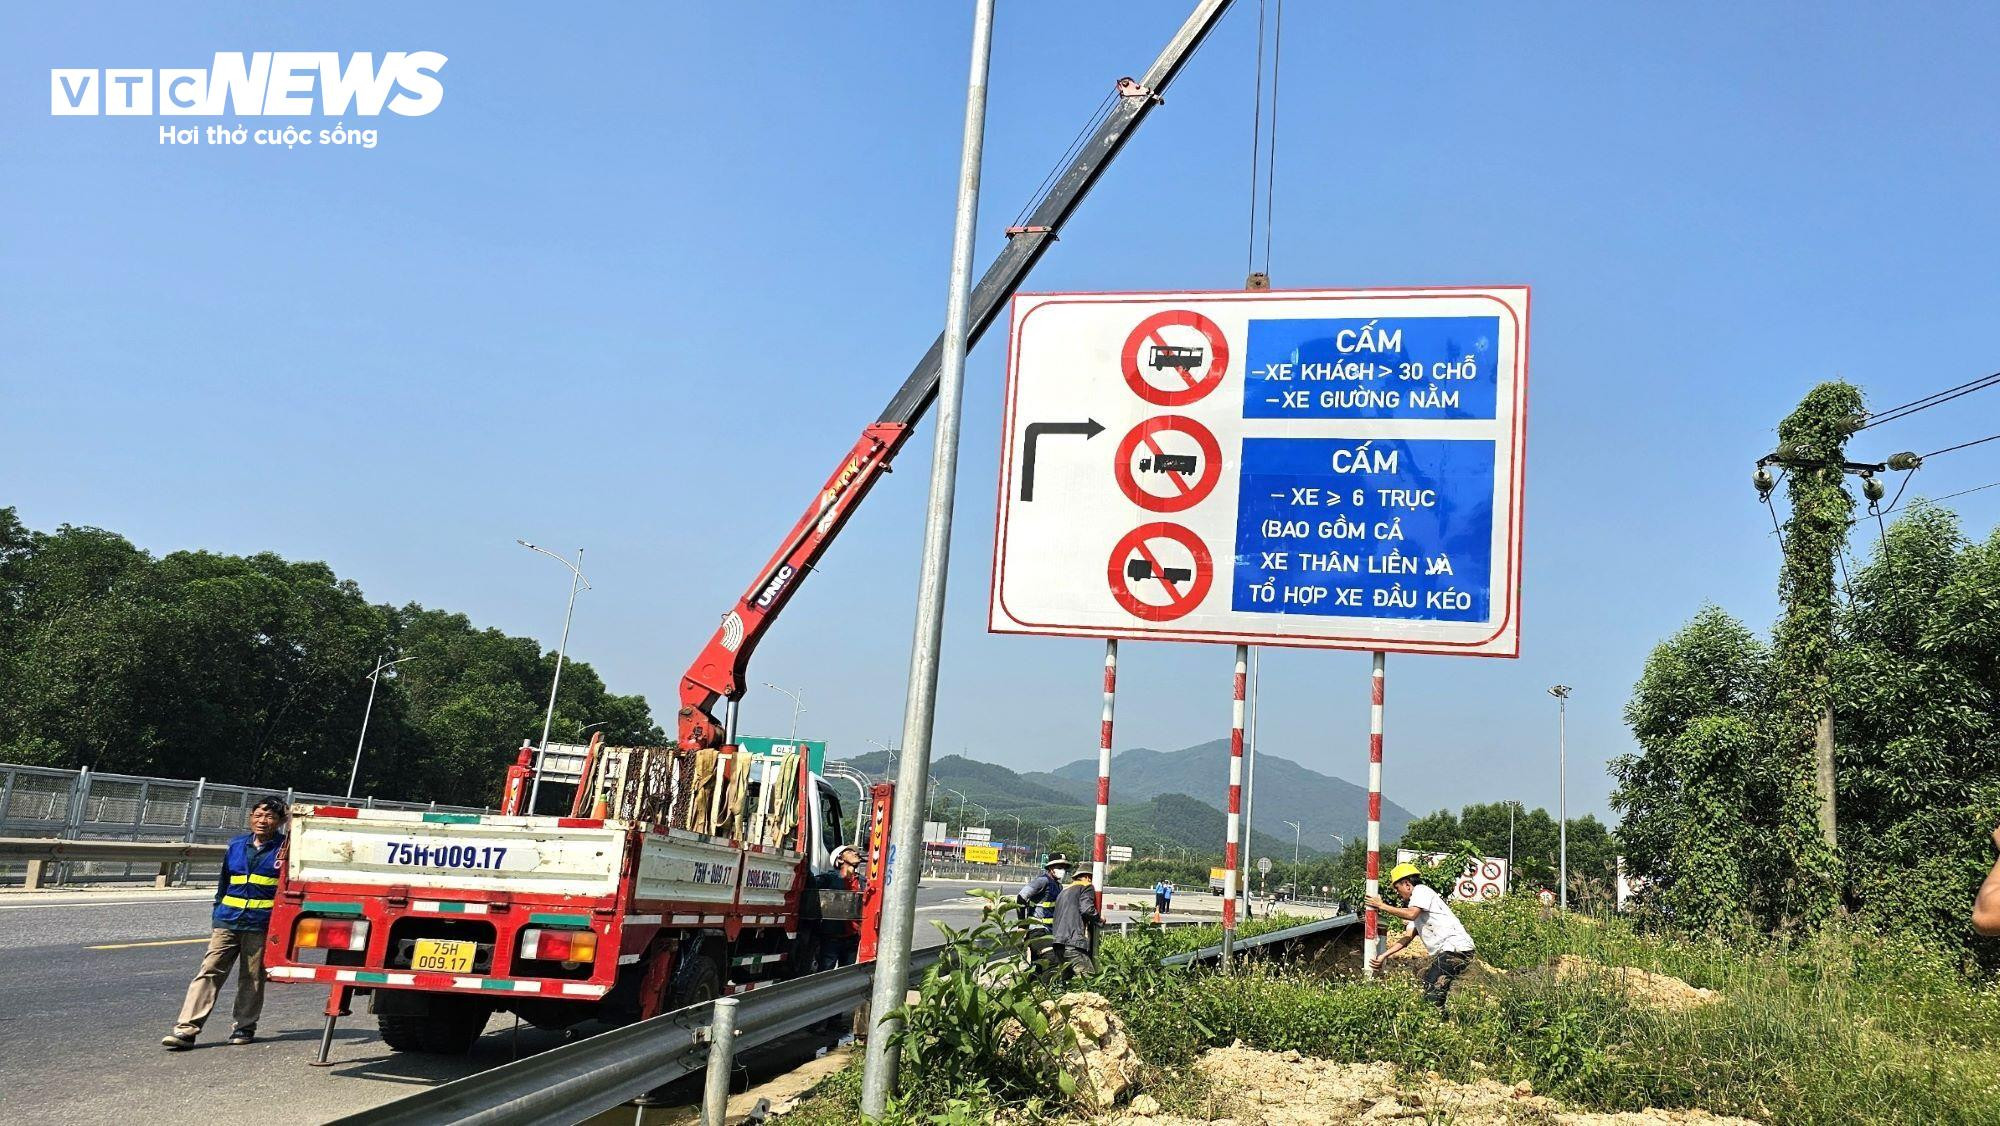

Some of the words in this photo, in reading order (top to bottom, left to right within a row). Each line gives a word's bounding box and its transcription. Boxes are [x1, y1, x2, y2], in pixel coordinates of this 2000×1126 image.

[1336, 320, 1402, 353] CẤM
[1301, 359, 1374, 381] KHÁCH
[1398, 362, 1423, 380] 30
[1432, 355, 1477, 380] CHỖ
[1320, 385, 1400, 409] GIƯỜNG
[1409, 383, 1459, 408] NẰM
[1332, 440, 1398, 474] CẤM
[1352, 489, 1364, 507] 6
[1377, 489, 1436, 511] TRỤC
[1261, 519, 1310, 539] (BAO
[1318, 513, 1366, 540] GỒM
[1374, 516, 1404, 541] CẢ
[1260, 552, 1289, 571] XE
[1299, 551, 1360, 573] THÂN
[1368, 547, 1417, 574] LIỀN
[1424, 553, 1454, 576] VÀ
[757, 565, 792, 606] UNIC
[1249, 576, 1276, 603] TỔ
[1284, 584, 1328, 607] HỢP
[1334, 587, 1364, 607] XE
[1373, 582, 1417, 608] ĐẦU
[1426, 586, 1472, 610] KÉO
[387, 842, 508, 870] 75H-009.17
[433, 943, 460, 955] 75H
[419, 956, 467, 971] 009.17
